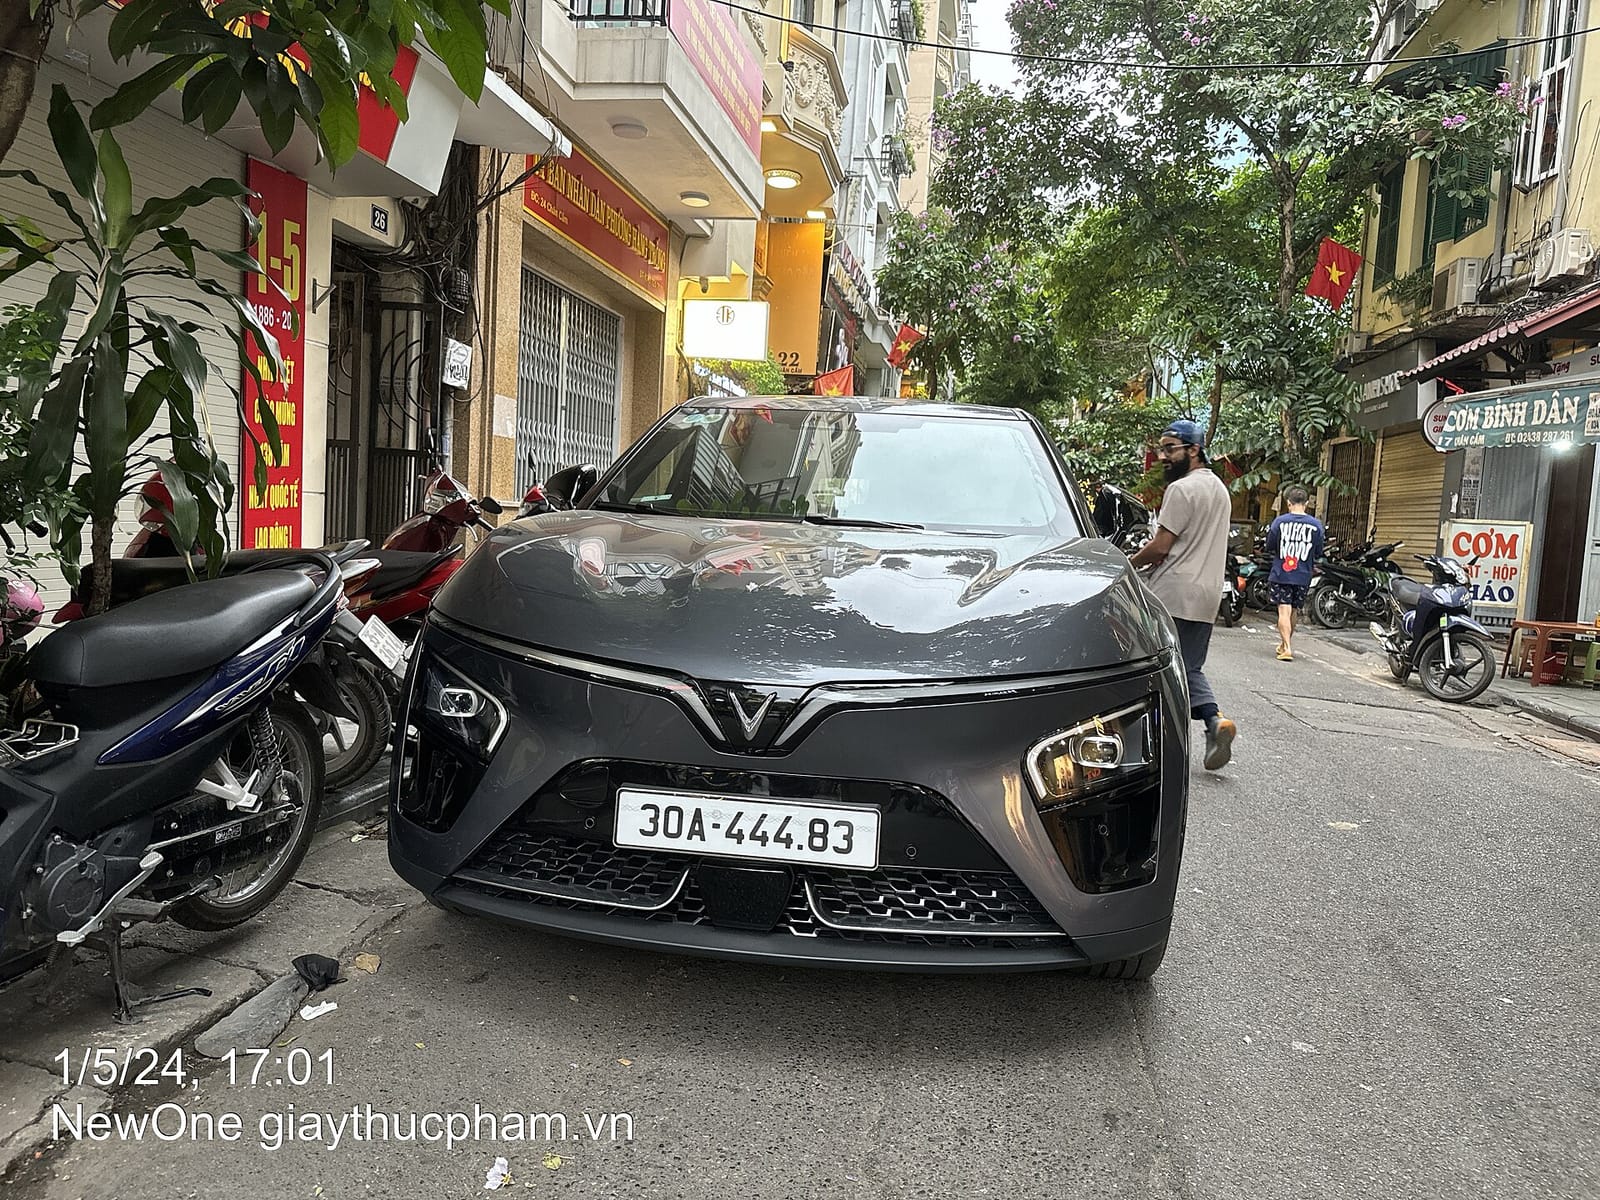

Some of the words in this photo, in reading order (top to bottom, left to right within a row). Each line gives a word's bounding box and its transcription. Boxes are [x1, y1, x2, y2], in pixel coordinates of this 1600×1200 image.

[374, 210, 387, 231] 26
[257, 210, 301, 302] 1-5
[778, 352, 800, 367] 22
[1443, 404, 1481, 433] CƠM
[1482, 398, 1528, 430] BÌNH
[1530, 390, 1580, 426] DÂN
[1437, 436, 1453, 447] 17
[1542, 430, 1558, 442] 287
[1560, 430, 1574, 441] 261
[270, 477, 289, 511] QUỐC
[290, 477, 299, 508] TẾ
[255, 526, 268, 549] LAO
[1280, 522, 1317, 543] WHAT
[1452, 527, 1519, 559] CƠM
[1493, 564, 1518, 583] HỘP
[1469, 580, 1514, 602] HÁO
[639, 803, 855, 855] 30A-444.83
